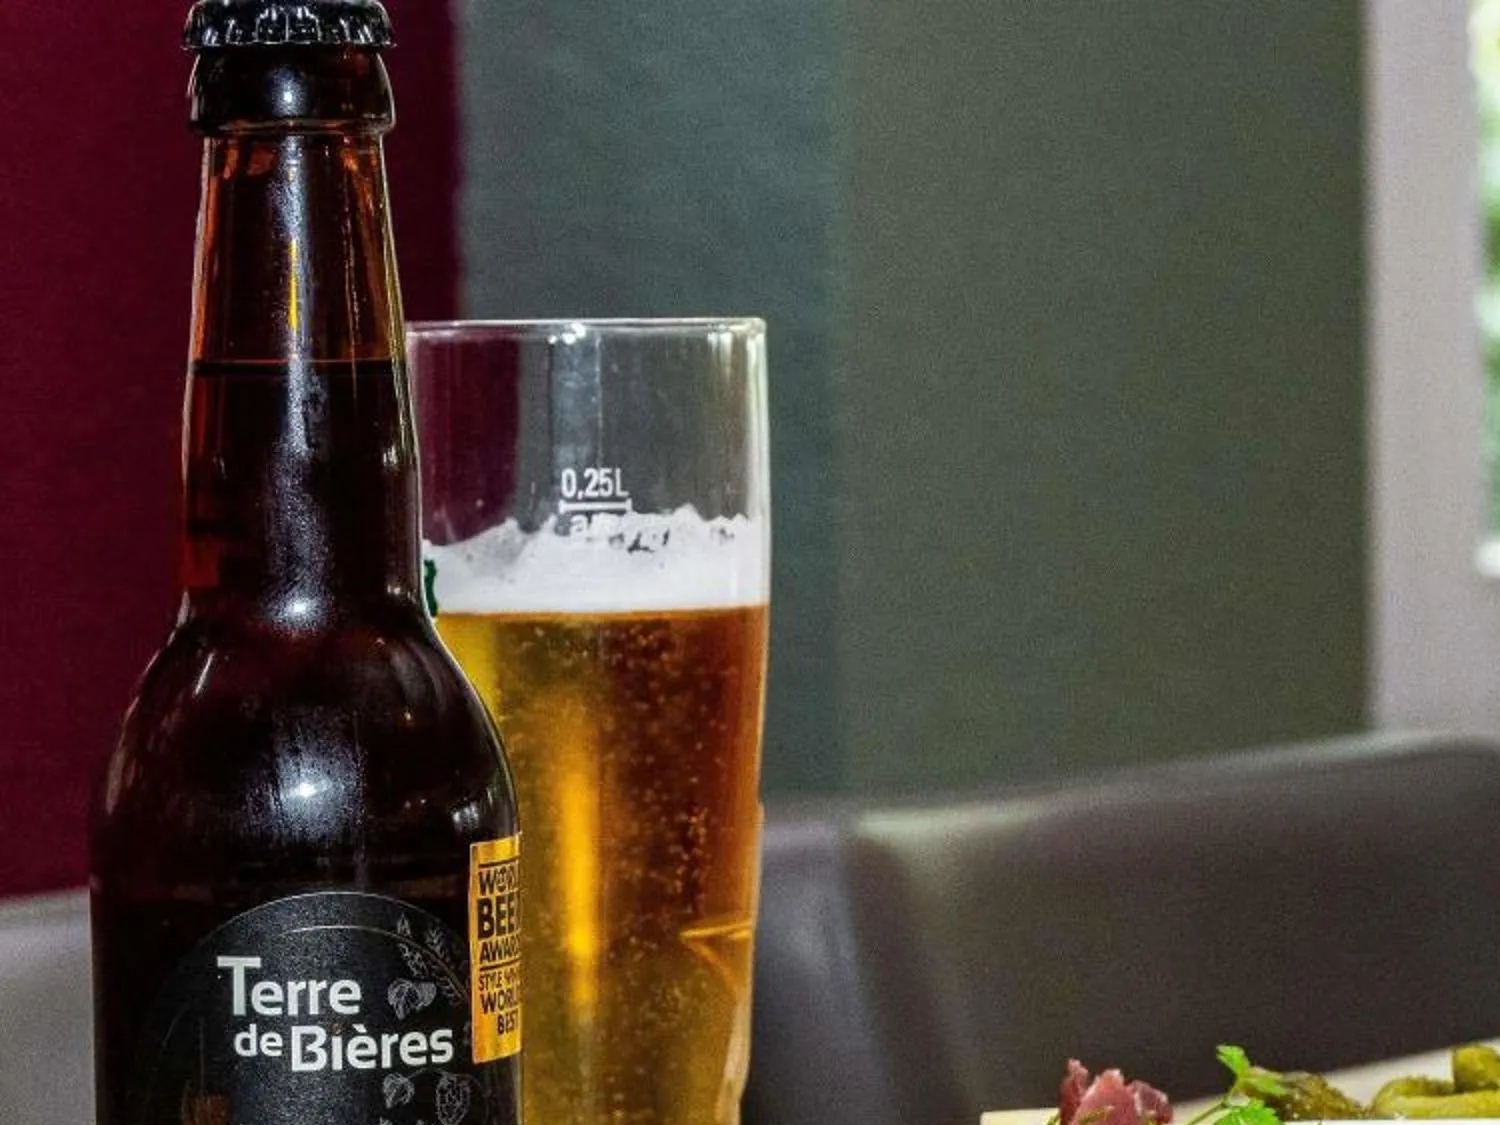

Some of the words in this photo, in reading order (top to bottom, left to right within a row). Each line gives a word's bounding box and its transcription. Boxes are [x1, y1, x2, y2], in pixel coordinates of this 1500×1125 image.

[561, 468, 629, 500] 0,25L
[477, 892, 520, 939] BEE
[217, 956, 361, 1016] Terre
[234, 1024, 283, 1057] de
[291, 1024, 454, 1071] Bières
